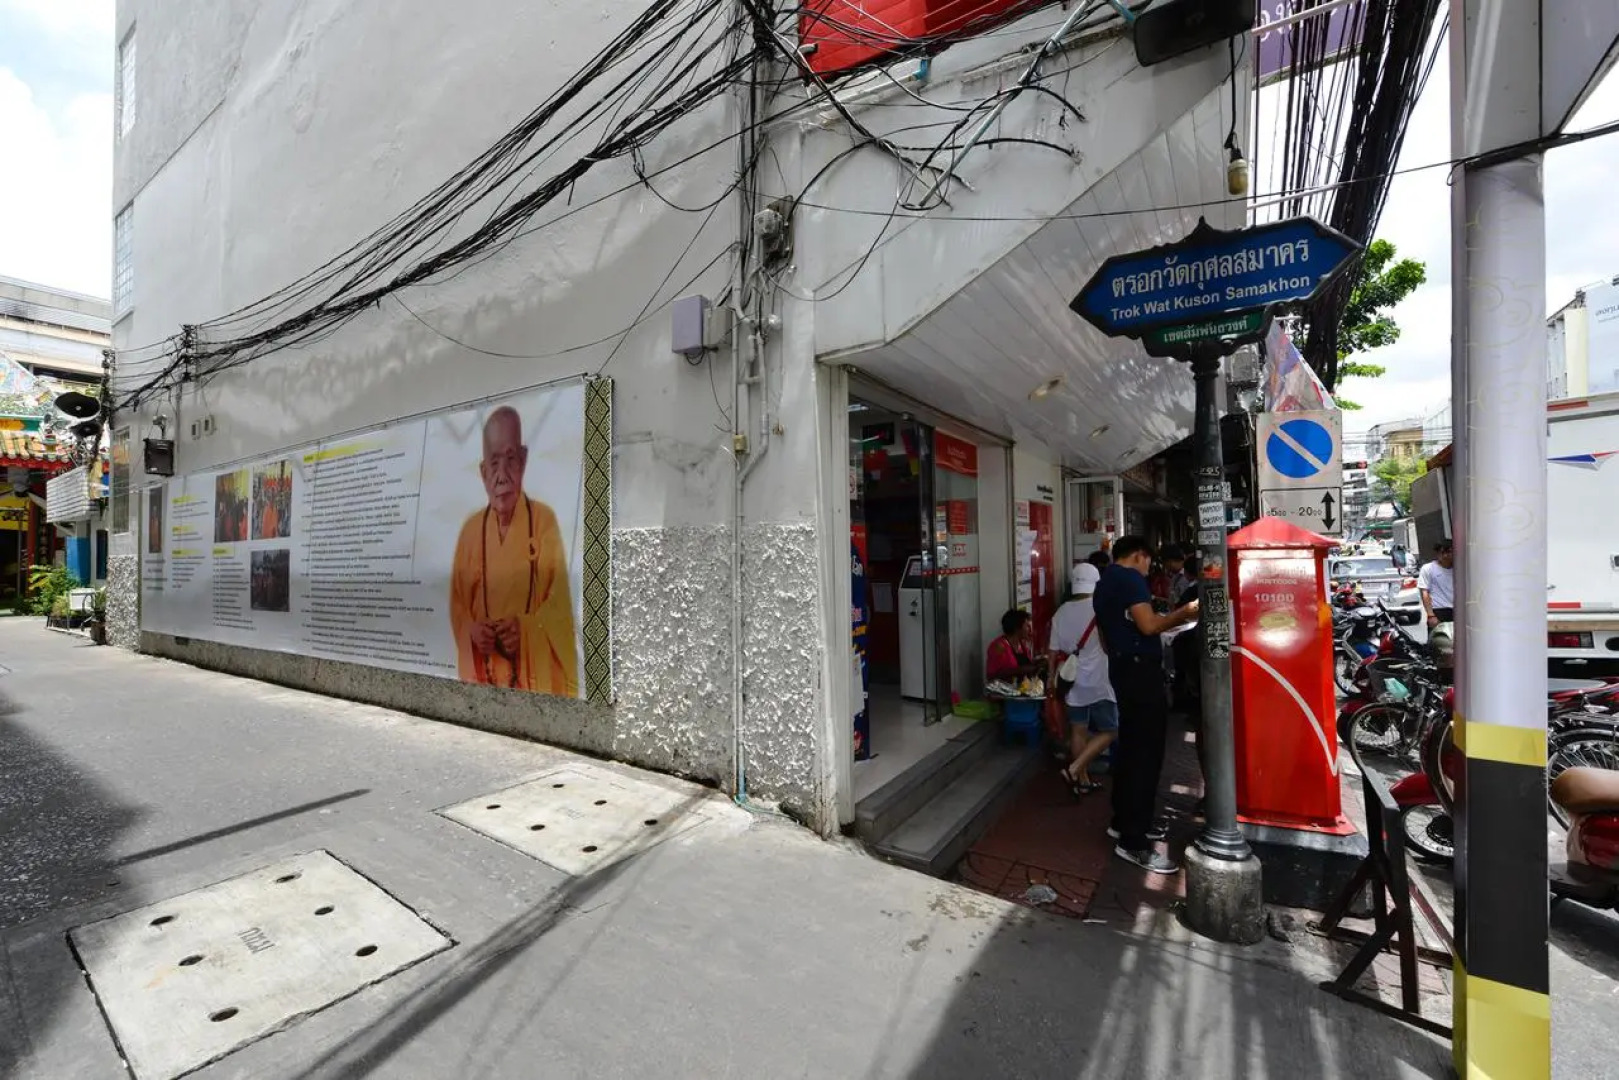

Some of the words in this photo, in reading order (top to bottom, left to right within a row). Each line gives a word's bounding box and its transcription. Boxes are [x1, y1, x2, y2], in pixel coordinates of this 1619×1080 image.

[1111, 238, 1310, 299] ตรอกวัดกุศลสมาคร
[1111, 304, 1141, 321] Trok
[1143, 300, 1171, 315] Wat
[1174, 292, 1220, 309] Kuson
[1225, 275, 1310, 300] Samakhon
[1254, 592, 1295, 603] 10100
